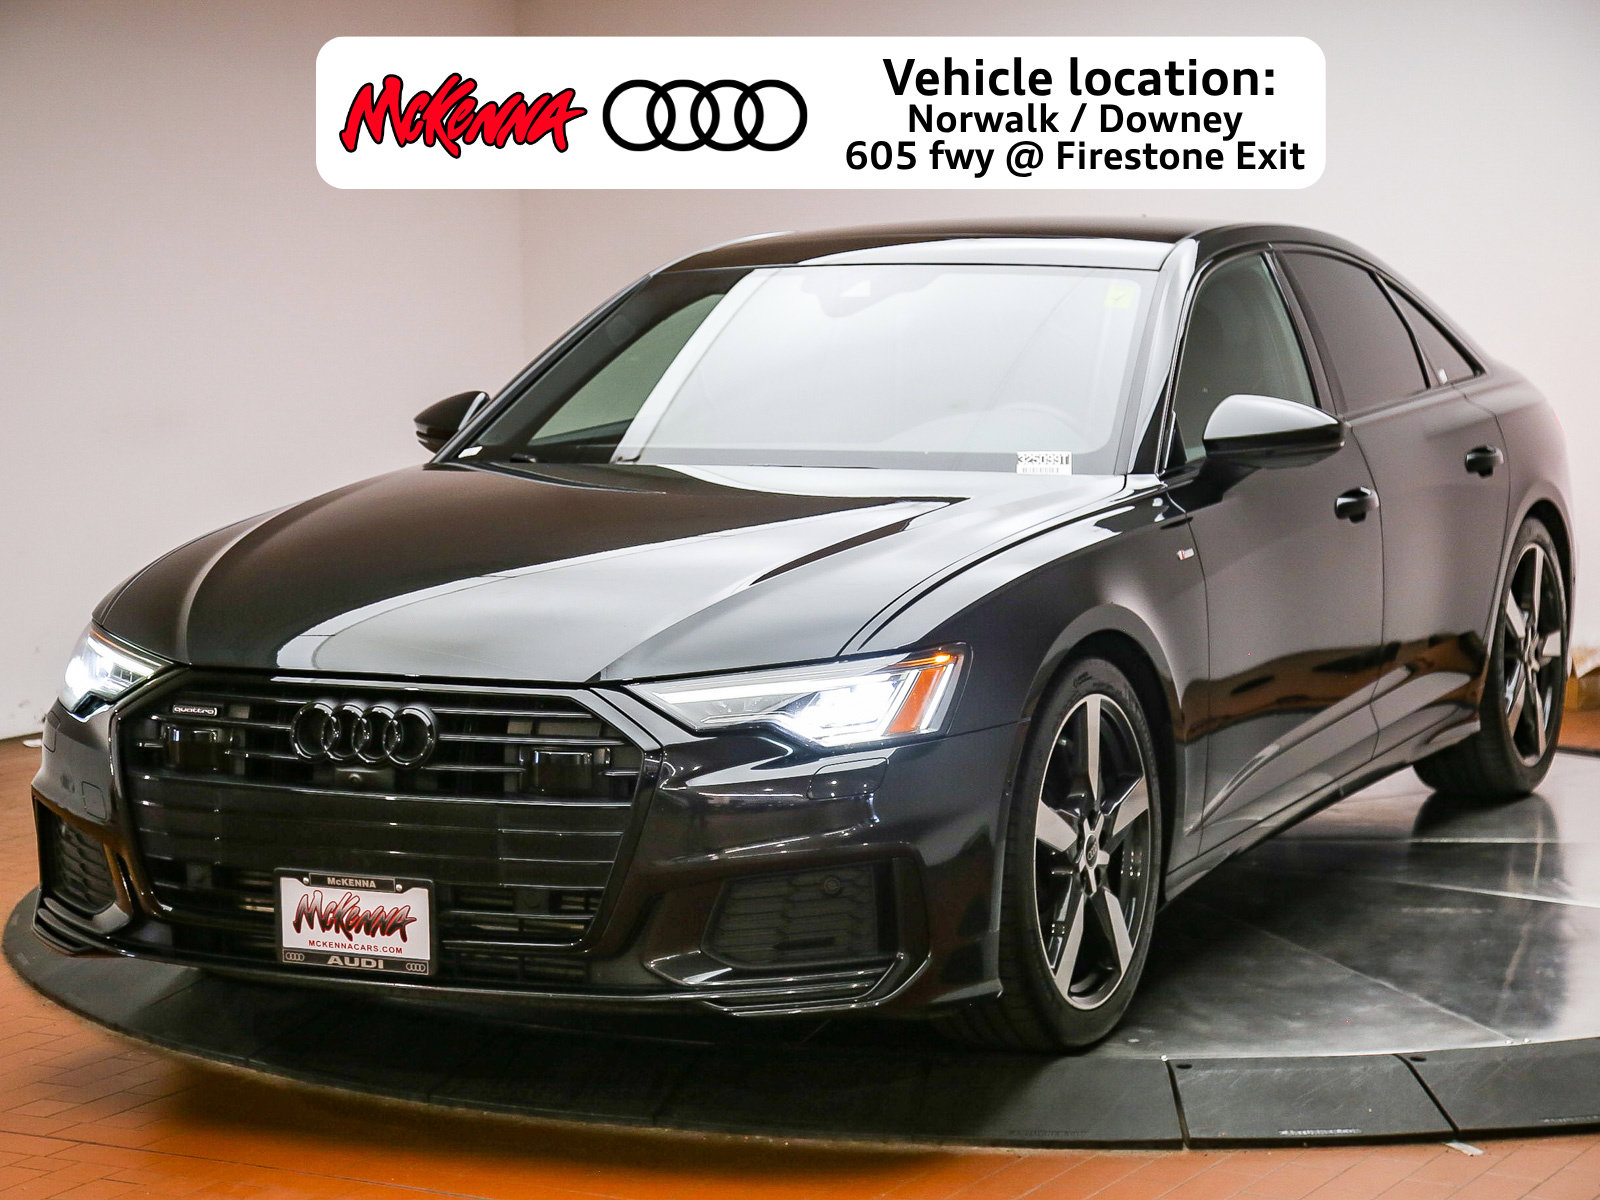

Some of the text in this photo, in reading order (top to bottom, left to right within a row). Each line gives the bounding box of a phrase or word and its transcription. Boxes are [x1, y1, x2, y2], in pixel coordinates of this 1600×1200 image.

[174, 706, 215, 715] quattro
[327, 876, 376, 889] McKENNA
[308, 939, 403, 954] MCKENNACARS.COM
[327, 955, 384, 969] AUDI
